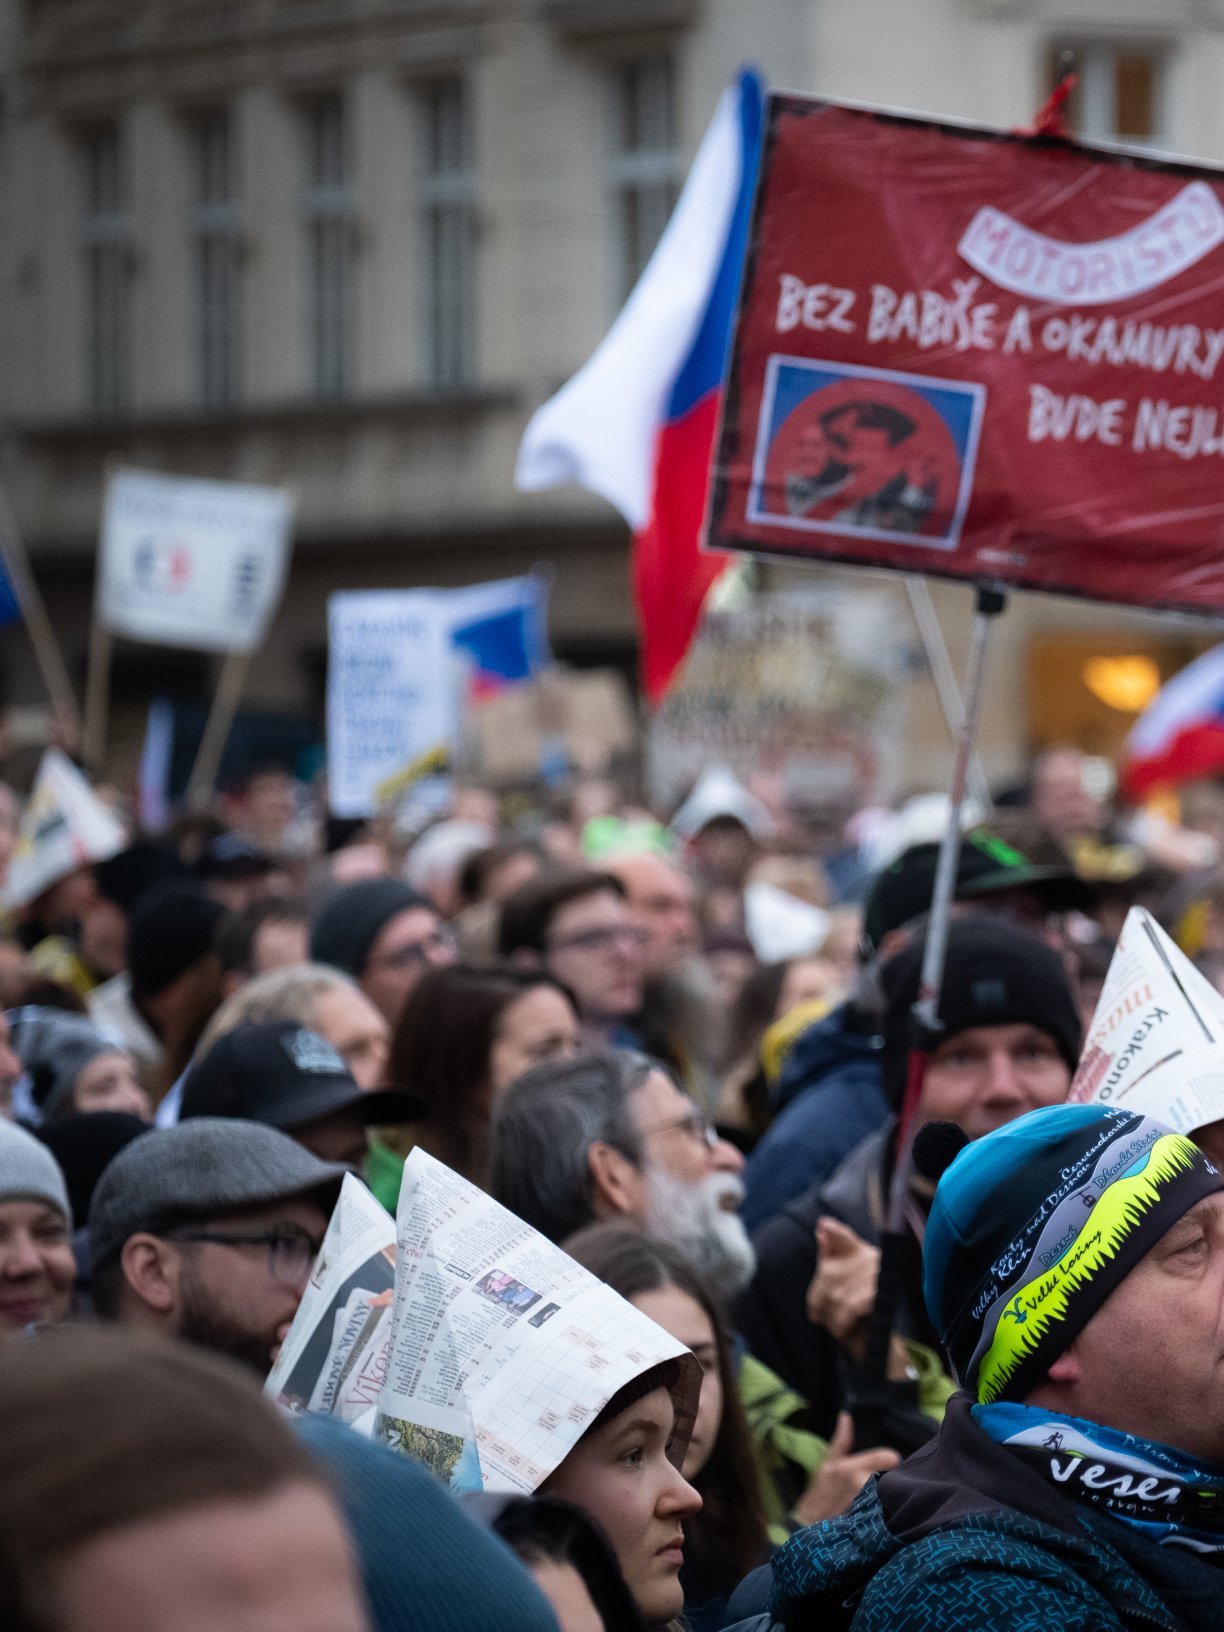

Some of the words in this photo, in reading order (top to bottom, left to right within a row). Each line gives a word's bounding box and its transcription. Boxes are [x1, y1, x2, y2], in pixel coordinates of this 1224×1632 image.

[776, 273, 857, 334] BEZ
[866, 275, 999, 352] BABIŠE
[1003, 305, 1033, 354] A
[1029, 383, 1124, 444] BUDE
[1098, 1006, 1170, 1104] Krakono
[990, 1239, 1024, 1275] Kouty
[1026, 1205, 1049, 1235] nad
[1025, 1274, 1060, 1311] Velké
[1059, 1230, 1103, 1275] Losiny
[1039, 1224, 1078, 1268] Desná
[337, 1300, 372, 1352] NOVINY
